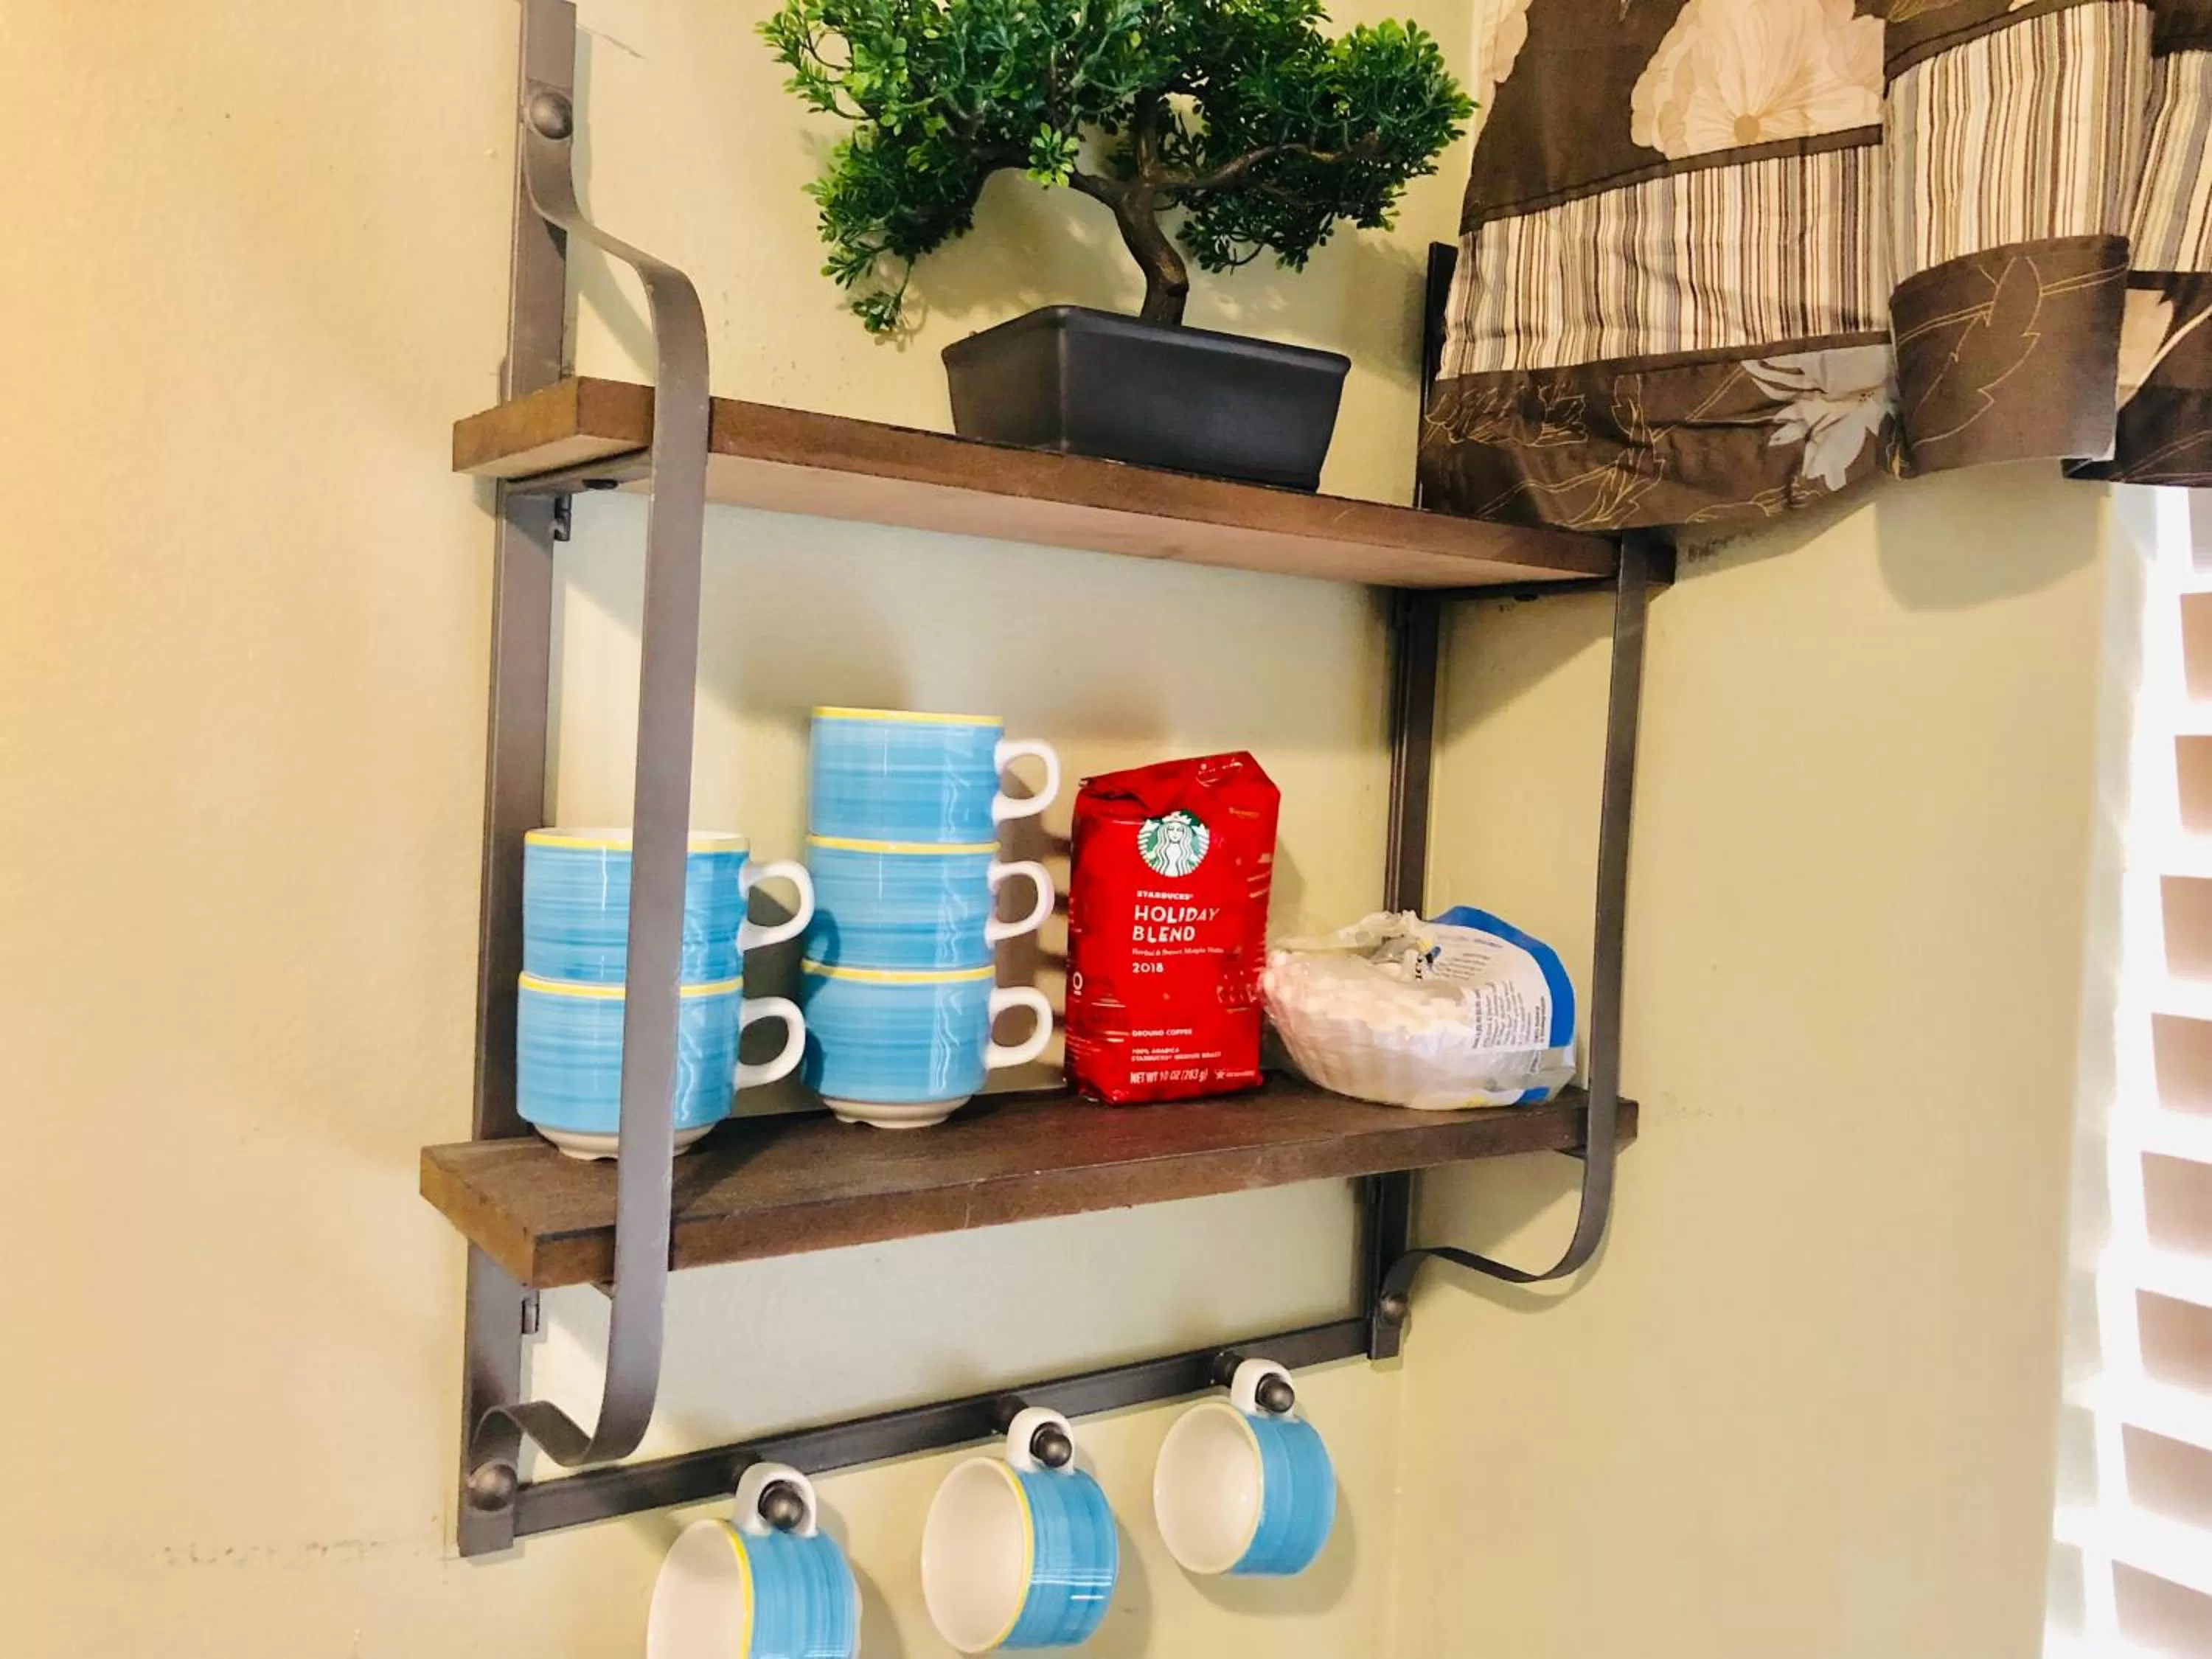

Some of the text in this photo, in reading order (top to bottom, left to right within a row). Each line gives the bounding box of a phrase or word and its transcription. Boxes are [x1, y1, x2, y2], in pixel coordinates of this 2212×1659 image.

[1134, 905, 1220, 924] HOLIDAY
[1132, 925, 1195, 943] BLEND
[1132, 961, 1164, 973] 2018
[1130, 1071, 1145, 1084] NET
[1145, 1071, 1159, 1083] WT
